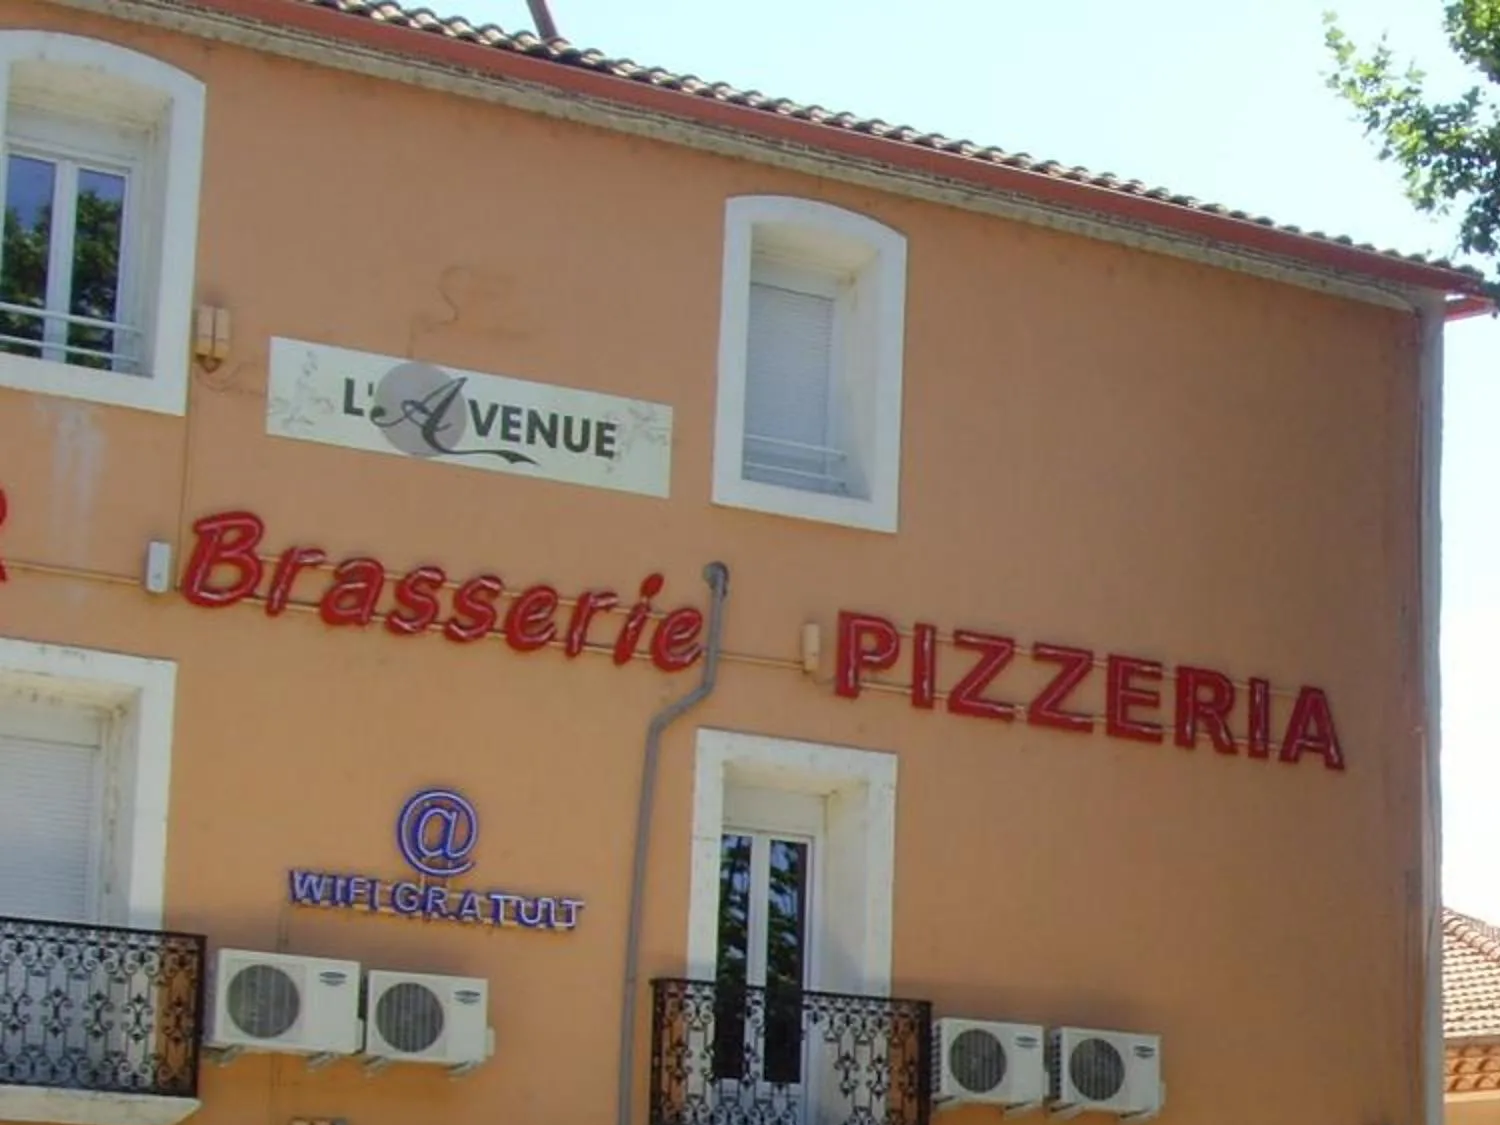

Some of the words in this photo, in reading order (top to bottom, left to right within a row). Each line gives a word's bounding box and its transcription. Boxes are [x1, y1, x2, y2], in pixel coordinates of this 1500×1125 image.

[342, 376, 617, 465] L'AVENUE
[181, 510, 703, 673] Brasserie
[835, 610, 1345, 771] PIZZERIA
[289, 869, 384, 911] WIFI
[390, 882, 585, 931] GRATUIT
